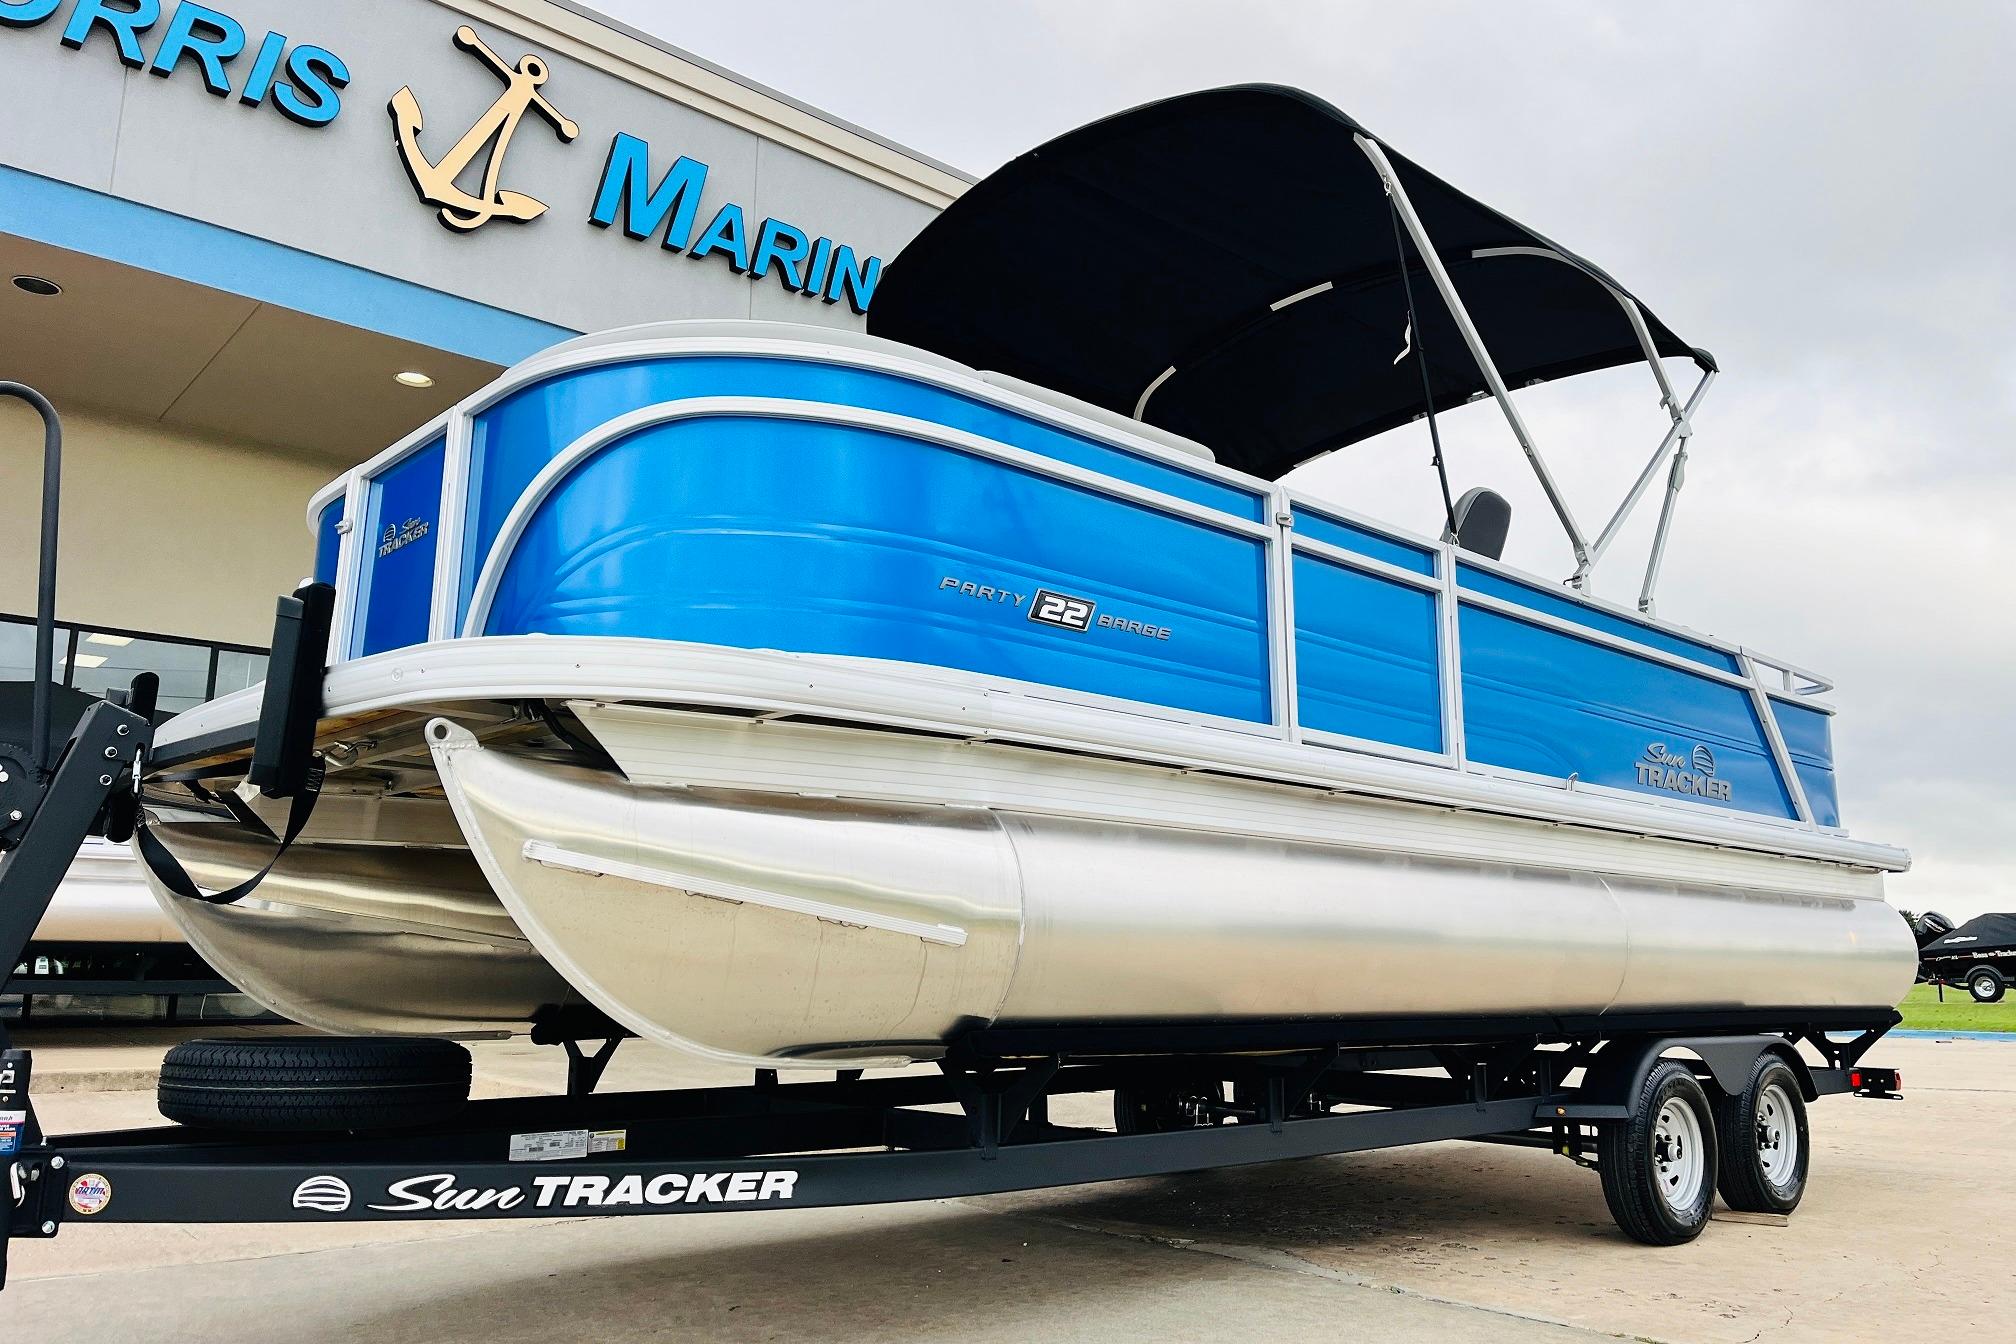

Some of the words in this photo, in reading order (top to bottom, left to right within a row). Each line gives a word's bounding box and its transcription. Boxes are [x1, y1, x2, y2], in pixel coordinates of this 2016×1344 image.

[588, 131, 890, 315] MARIN
[379, 522, 429, 557] TRACKER
[939, 576, 1027, 607] PARTY
[1038, 595, 1088, 627] 22
[1096, 614, 1172, 641] BARGE
[1643, 742, 1686, 769] Sun
[1634, 761, 1732, 801] TRACKER
[366, 1173, 526, 1211] Sun
[532, 1170, 799, 1207] TRACKER
